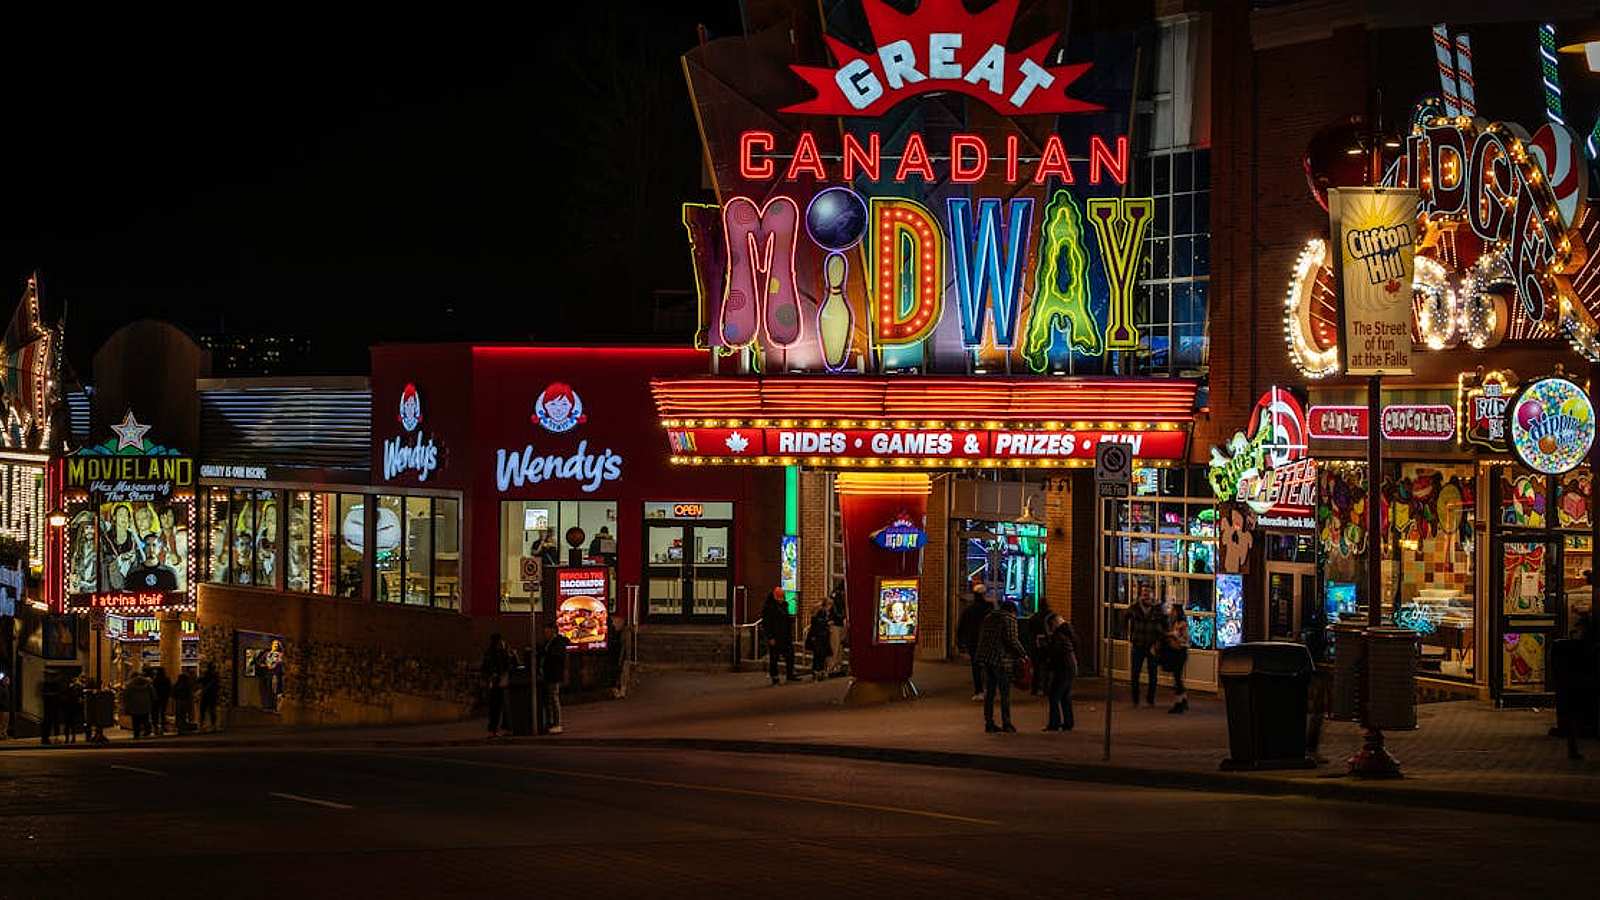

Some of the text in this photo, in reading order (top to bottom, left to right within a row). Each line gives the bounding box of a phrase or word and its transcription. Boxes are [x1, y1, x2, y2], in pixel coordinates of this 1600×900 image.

[834, 33, 1056, 109] GREAT
[740, 131, 1128, 184] CANADIAN
[1347, 224, 1411, 259] Clifton
[1367, 252, 1405, 284] Hill
[1352, 321, 1407, 335] The Street
[1364, 336, 1395, 350] of fun
[1352, 352, 1408, 366] at the Falls
[1321, 411, 1359, 434] CANDY
[779, 432, 846, 453] RIDES
[871, 433, 952, 454] GAMES
[963, 433, 981, 454] &
[995, 434, 1077, 455] PRIZES
[383, 431, 438, 481] Wendy's
[496, 440, 623, 492] Wendy's
[68, 458, 193, 486] MOVIELAND
[157, 481, 170, 495] of
[674, 504, 702, 516] OPEN
[140, 592, 163, 605] Kaif
